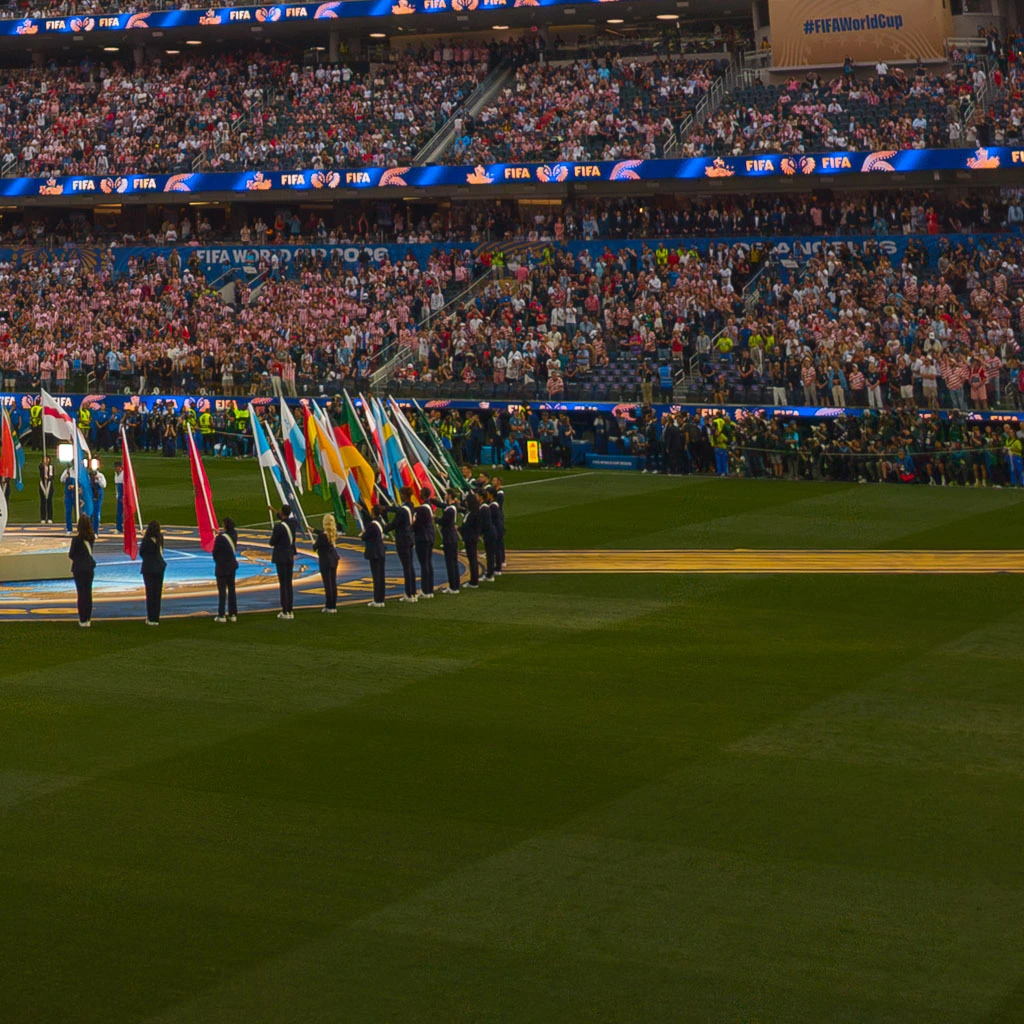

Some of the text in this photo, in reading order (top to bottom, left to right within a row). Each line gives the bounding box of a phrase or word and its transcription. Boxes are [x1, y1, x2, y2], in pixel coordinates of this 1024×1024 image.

[424, 0, 446, 9] FIFA
[230, 10, 251, 20] FIFA
[286, 7, 308, 17] FIFA
[46, 20, 66, 30] FIFA
[99, 17, 119, 27] FIFA
[803, 13, 903, 35] #FIFAWorldCup
[746, 160, 774, 171] FIFA
[822, 157, 851, 168] FIFA
[504, 167, 531, 179] FIFA
[574, 165, 601, 177] FIFA
[281, 174, 305, 185] FIFA
[346, 172, 370, 183] FIFA
[72, 180, 95, 190] FIFA
[133, 178, 156, 189] FIFA
[196, 249, 230, 264] FIFA
[232, 248, 291, 264] WORD
